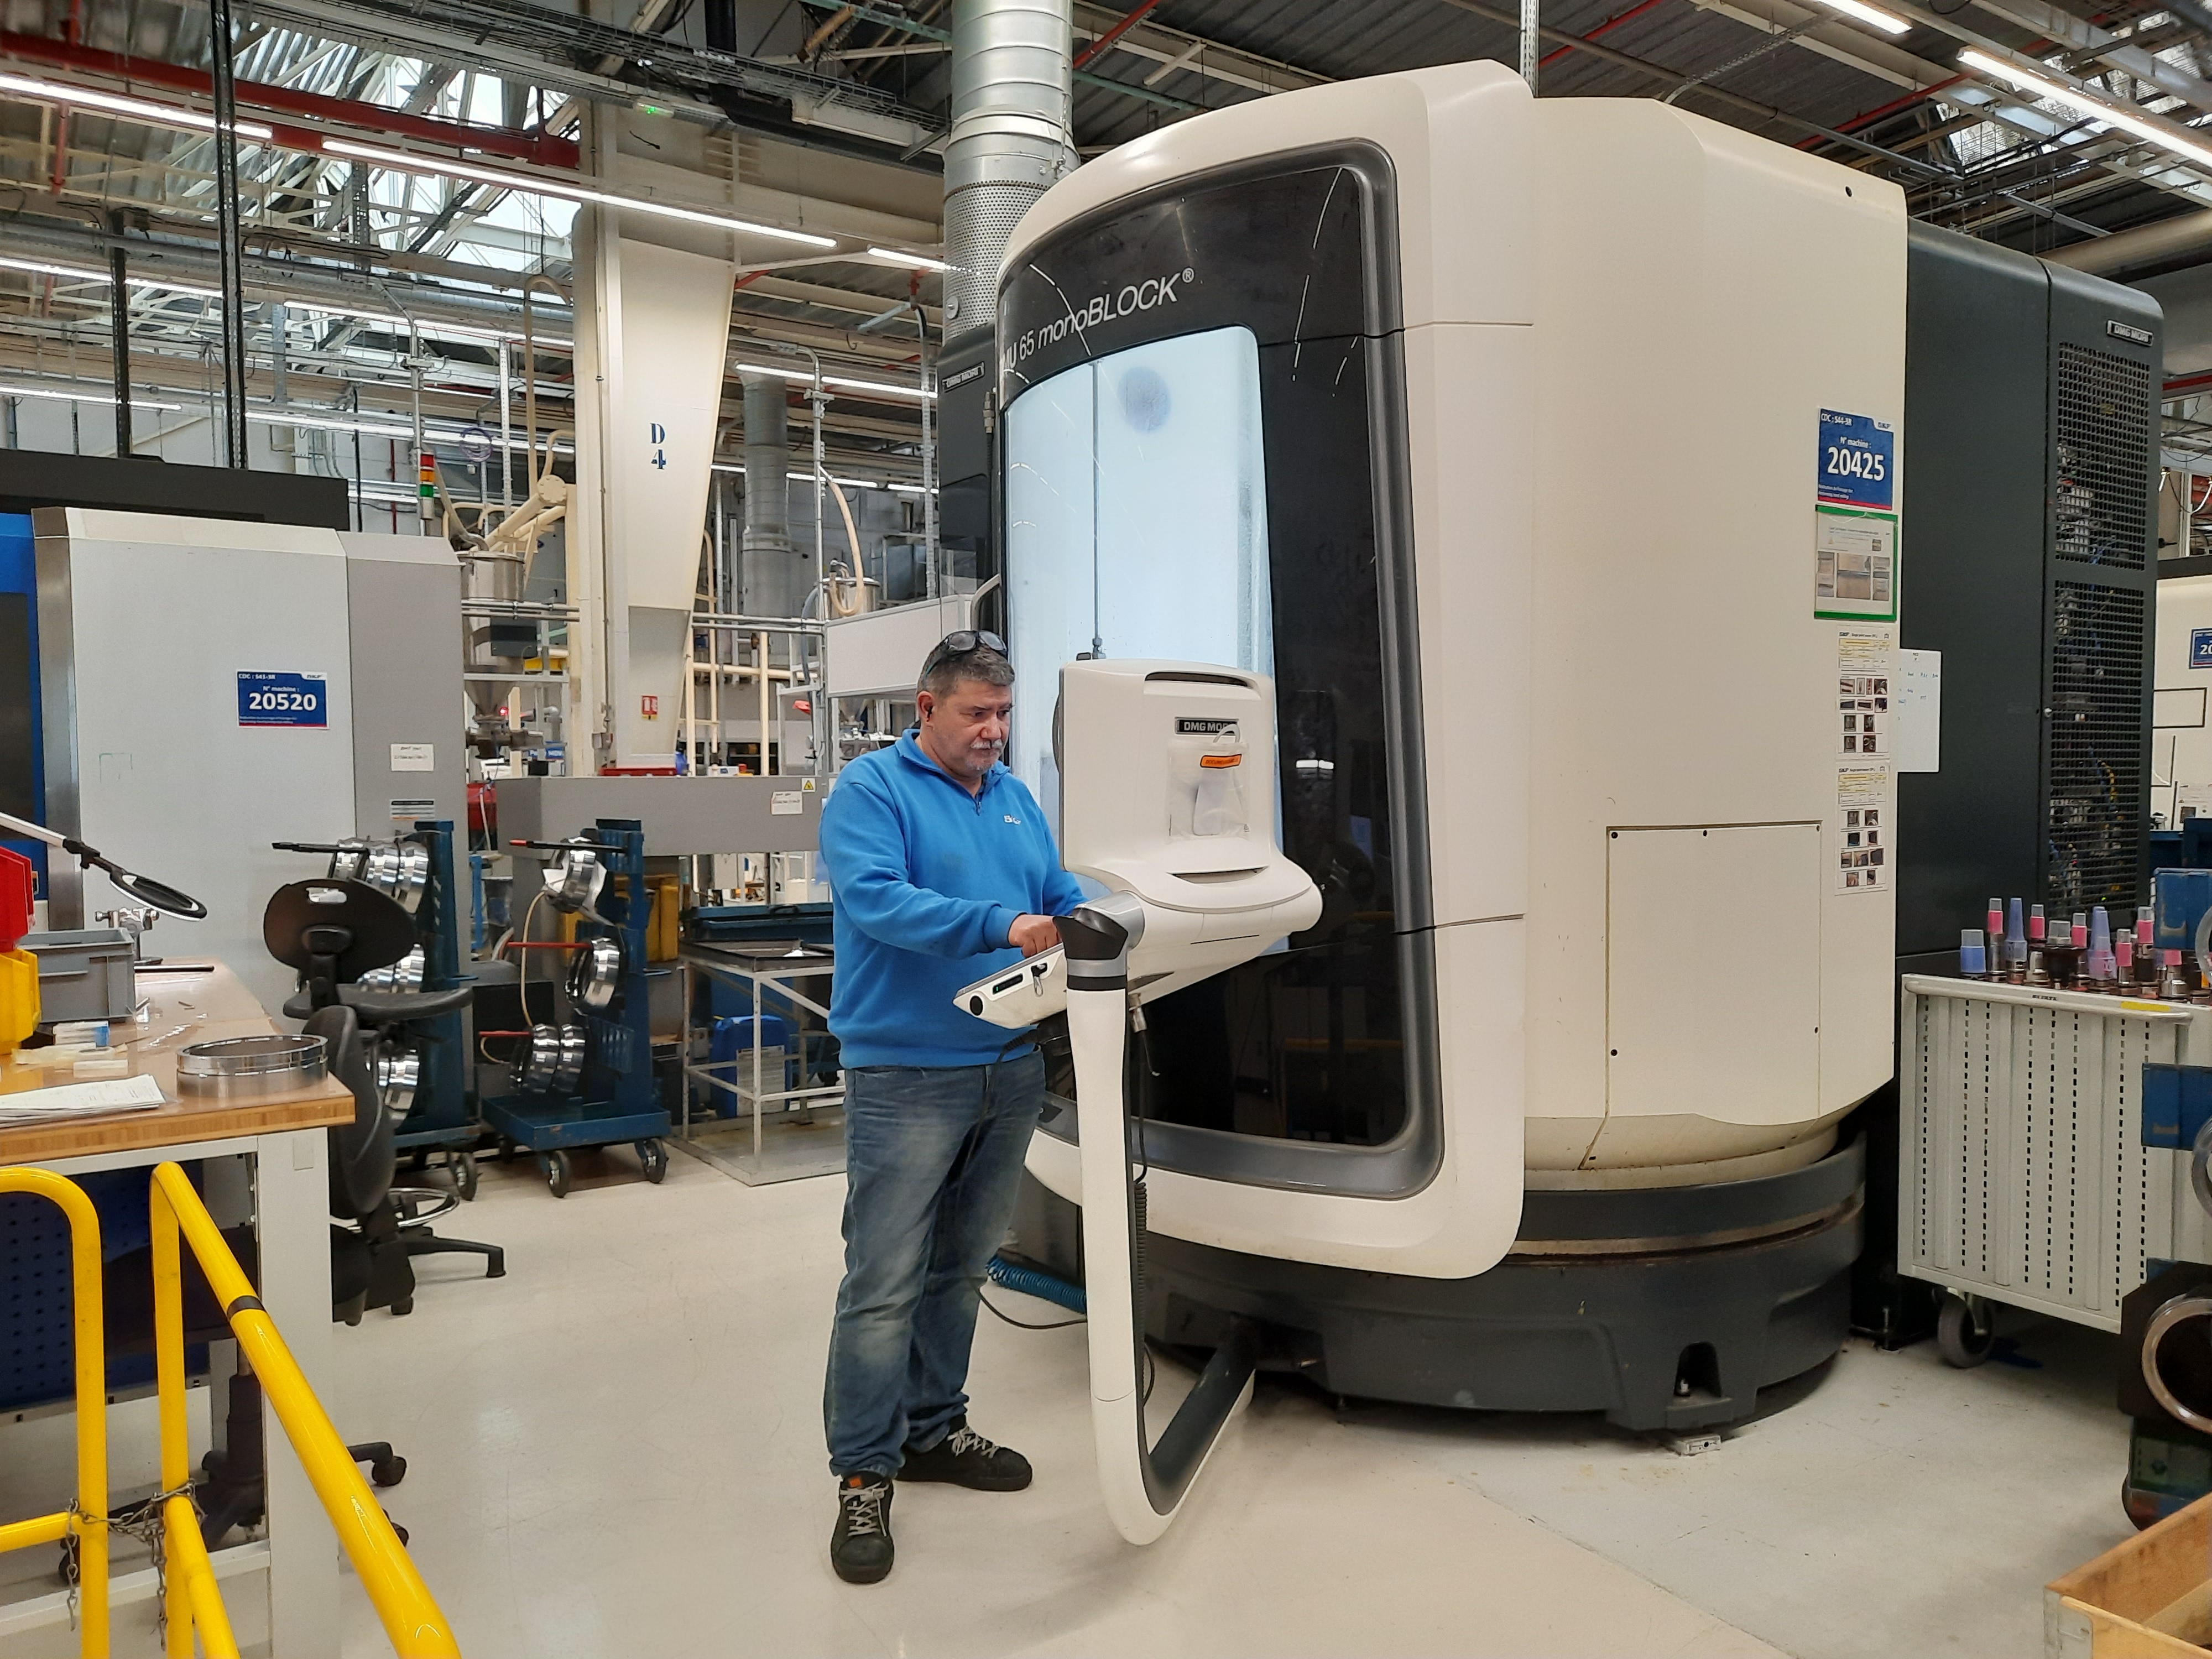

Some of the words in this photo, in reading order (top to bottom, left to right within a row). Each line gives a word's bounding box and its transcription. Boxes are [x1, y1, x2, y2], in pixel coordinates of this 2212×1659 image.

[1019, 330, 1034, 361] 65
[1820, 413, 1831, 422] CDC
[650, 423, 665, 444] D
[651, 449, 666, 470] 4
[1828, 446, 1885, 481] 20425
[249, 692, 317, 711] 20520
[1184, 722, 1206, 731] DMG
[1207, 722, 1229, 732] MO
